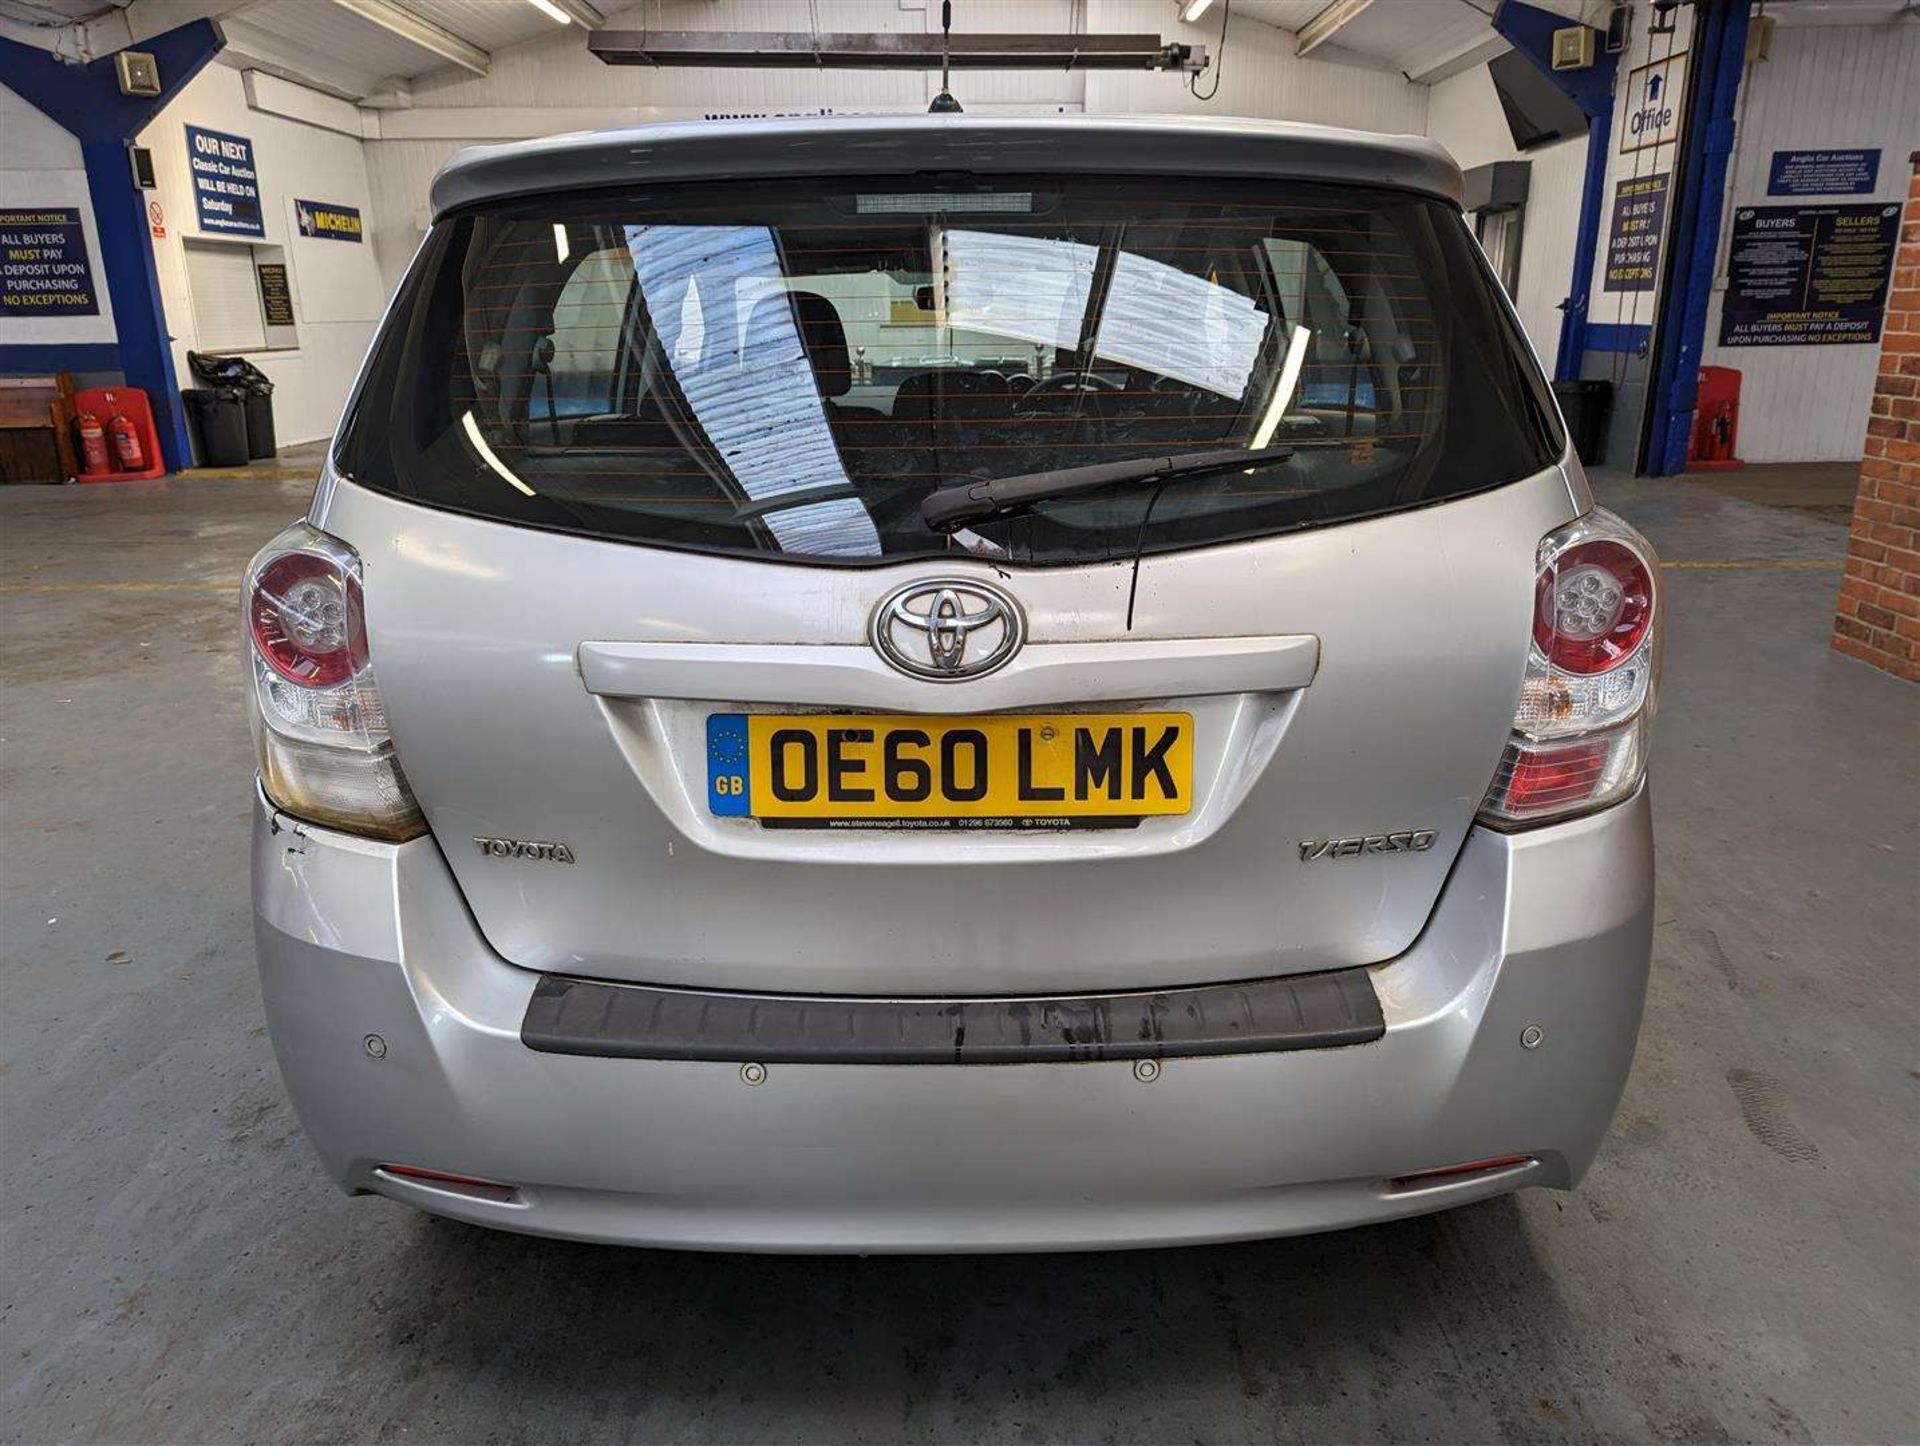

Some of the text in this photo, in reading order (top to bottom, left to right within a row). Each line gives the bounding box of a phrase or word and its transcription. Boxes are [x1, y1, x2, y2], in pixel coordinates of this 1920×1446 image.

[1631, 108, 1672, 135] Office
[195, 134, 247, 161] OUR NEXT
[1816, 154, 1830, 162] Car
[192, 157, 255, 180] Classic Car Auction
[197, 177, 256, 198] WILL BE HELD ON
[202, 197, 233, 216] Saturday
[1633, 201, 1656, 215] BUYES
[315, 211, 361, 233] MICHELIN
[1621, 219, 1639, 232] MST
[1755, 218, 1796, 229] BUYERS
[1835, 216, 1880, 228] SELLERS
[1, 233, 66, 245] ALL BUYERS
[8, 248, 63, 261] MUST PAY
[4, 264, 50, 276] DEPOSIT
[52, 263, 86, 275] UPON
[7, 279, 79, 291] PURCHASING
[3, 293, 89, 306] NO EXCEPTIONS
[1766, 310, 1841, 321] IMPORTANT NOTICE
[1733, 321, 1869, 333] ALL BUYERS MUST PAY A DEPOSIT
[1727, 332, 1873, 344] UPON PURCHASING NO EXCEPTIONS
[770, 726, 1179, 802] OE60 LMK
[715, 775, 744, 796] GB
[1035, 818, 1071, 826] TOYOTA
[473, 836, 575, 864] TOYOTA
[1299, 829, 1439, 861] VERSO
